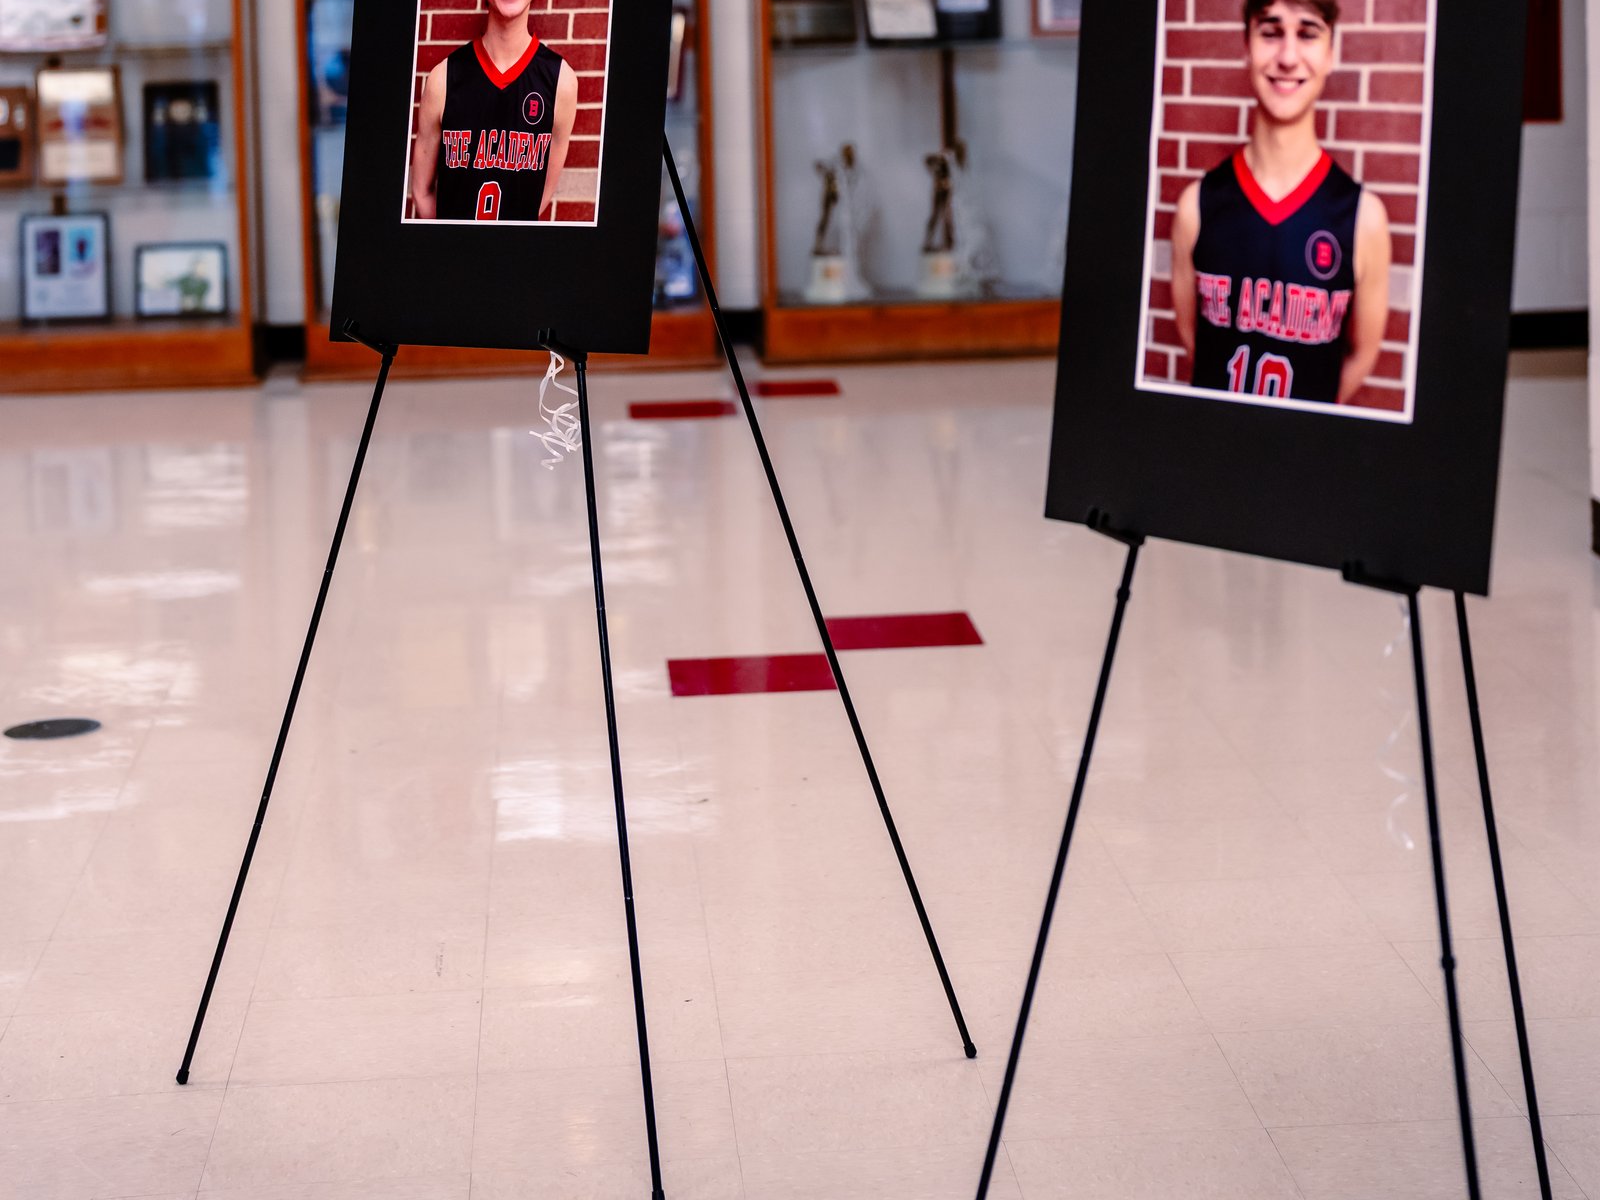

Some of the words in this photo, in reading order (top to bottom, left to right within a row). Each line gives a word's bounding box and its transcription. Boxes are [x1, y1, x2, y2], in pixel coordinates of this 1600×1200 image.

[529, 99, 539, 117] B
[443, 129, 472, 169] THE
[473, 129, 552, 171] ACADEMY
[1235, 277, 1354, 346] ACADEMY
[1227, 344, 1294, 399] 10
